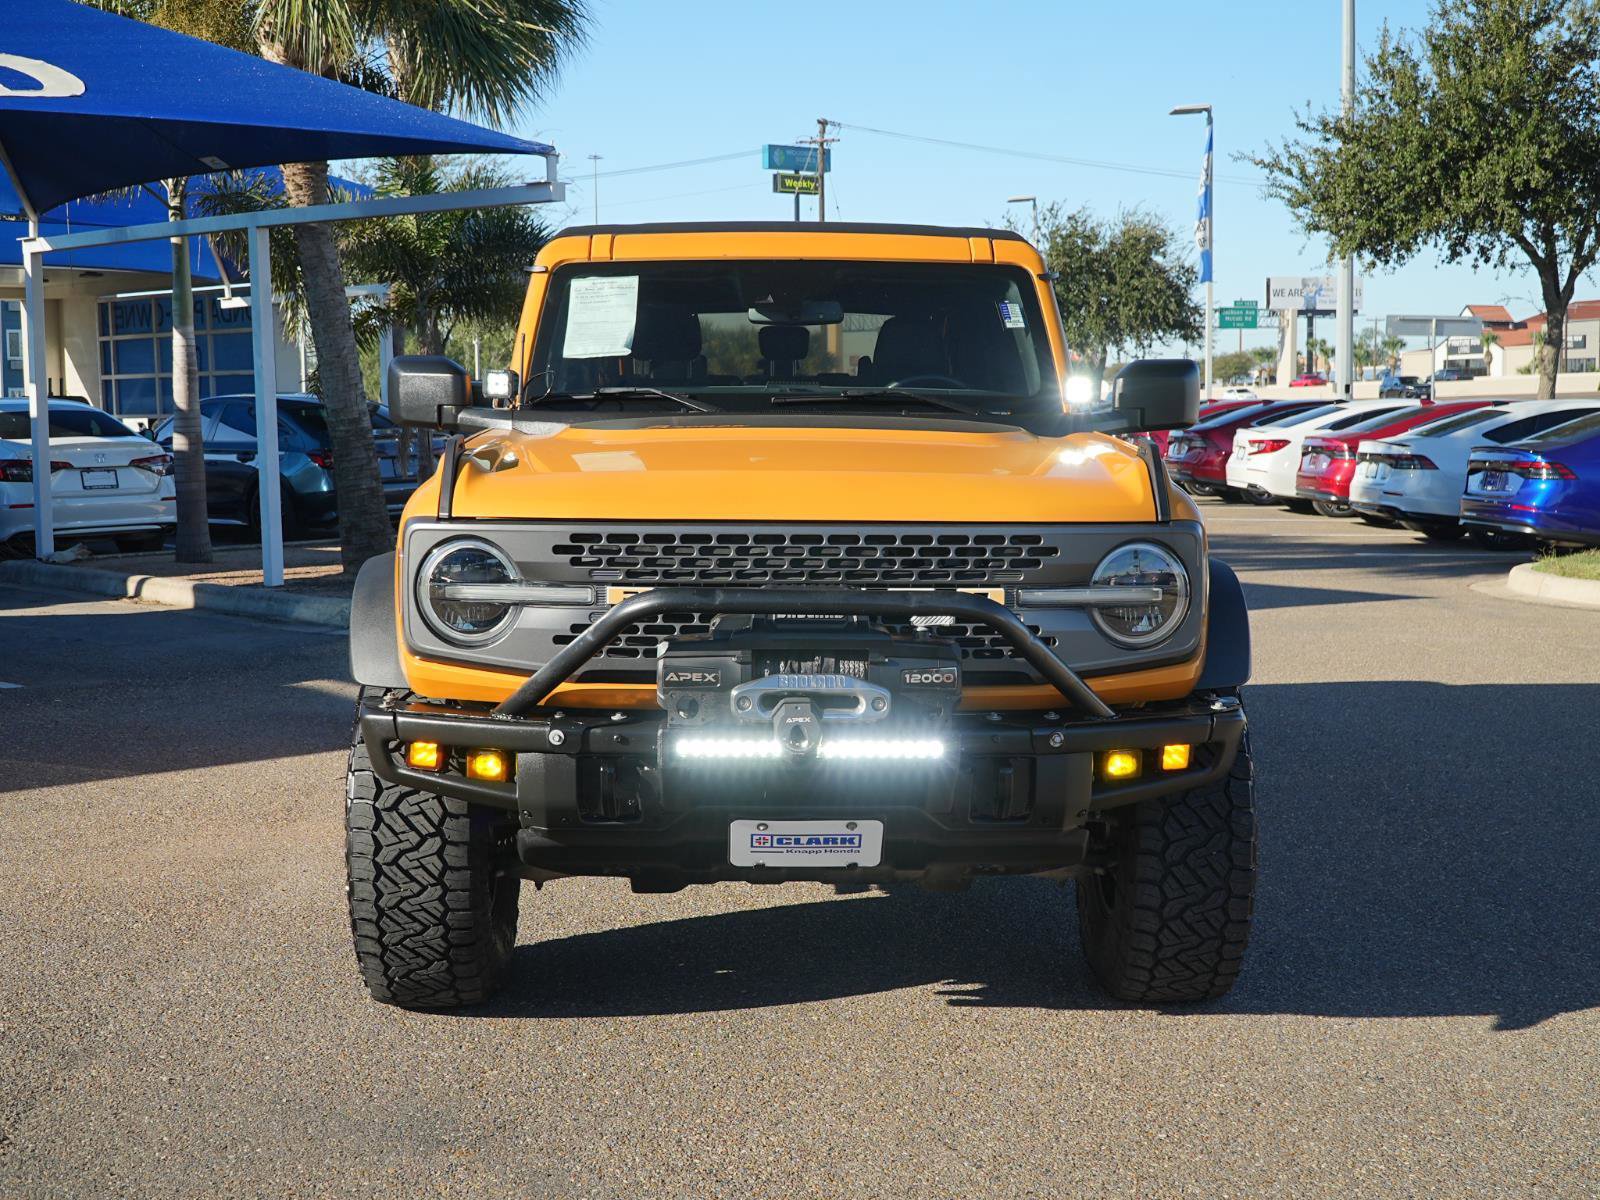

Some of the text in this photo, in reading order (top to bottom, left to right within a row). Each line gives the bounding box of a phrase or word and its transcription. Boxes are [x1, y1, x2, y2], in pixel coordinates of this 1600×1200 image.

[784, 178, 815, 190] Weekly
[1272, 288, 1305, 297] WE ARE
[665, 672, 718, 682] APEX
[777, 674, 846, 688] BADLAND
[904, 673, 954, 684] 12000
[776, 836, 856, 846] CLARK
